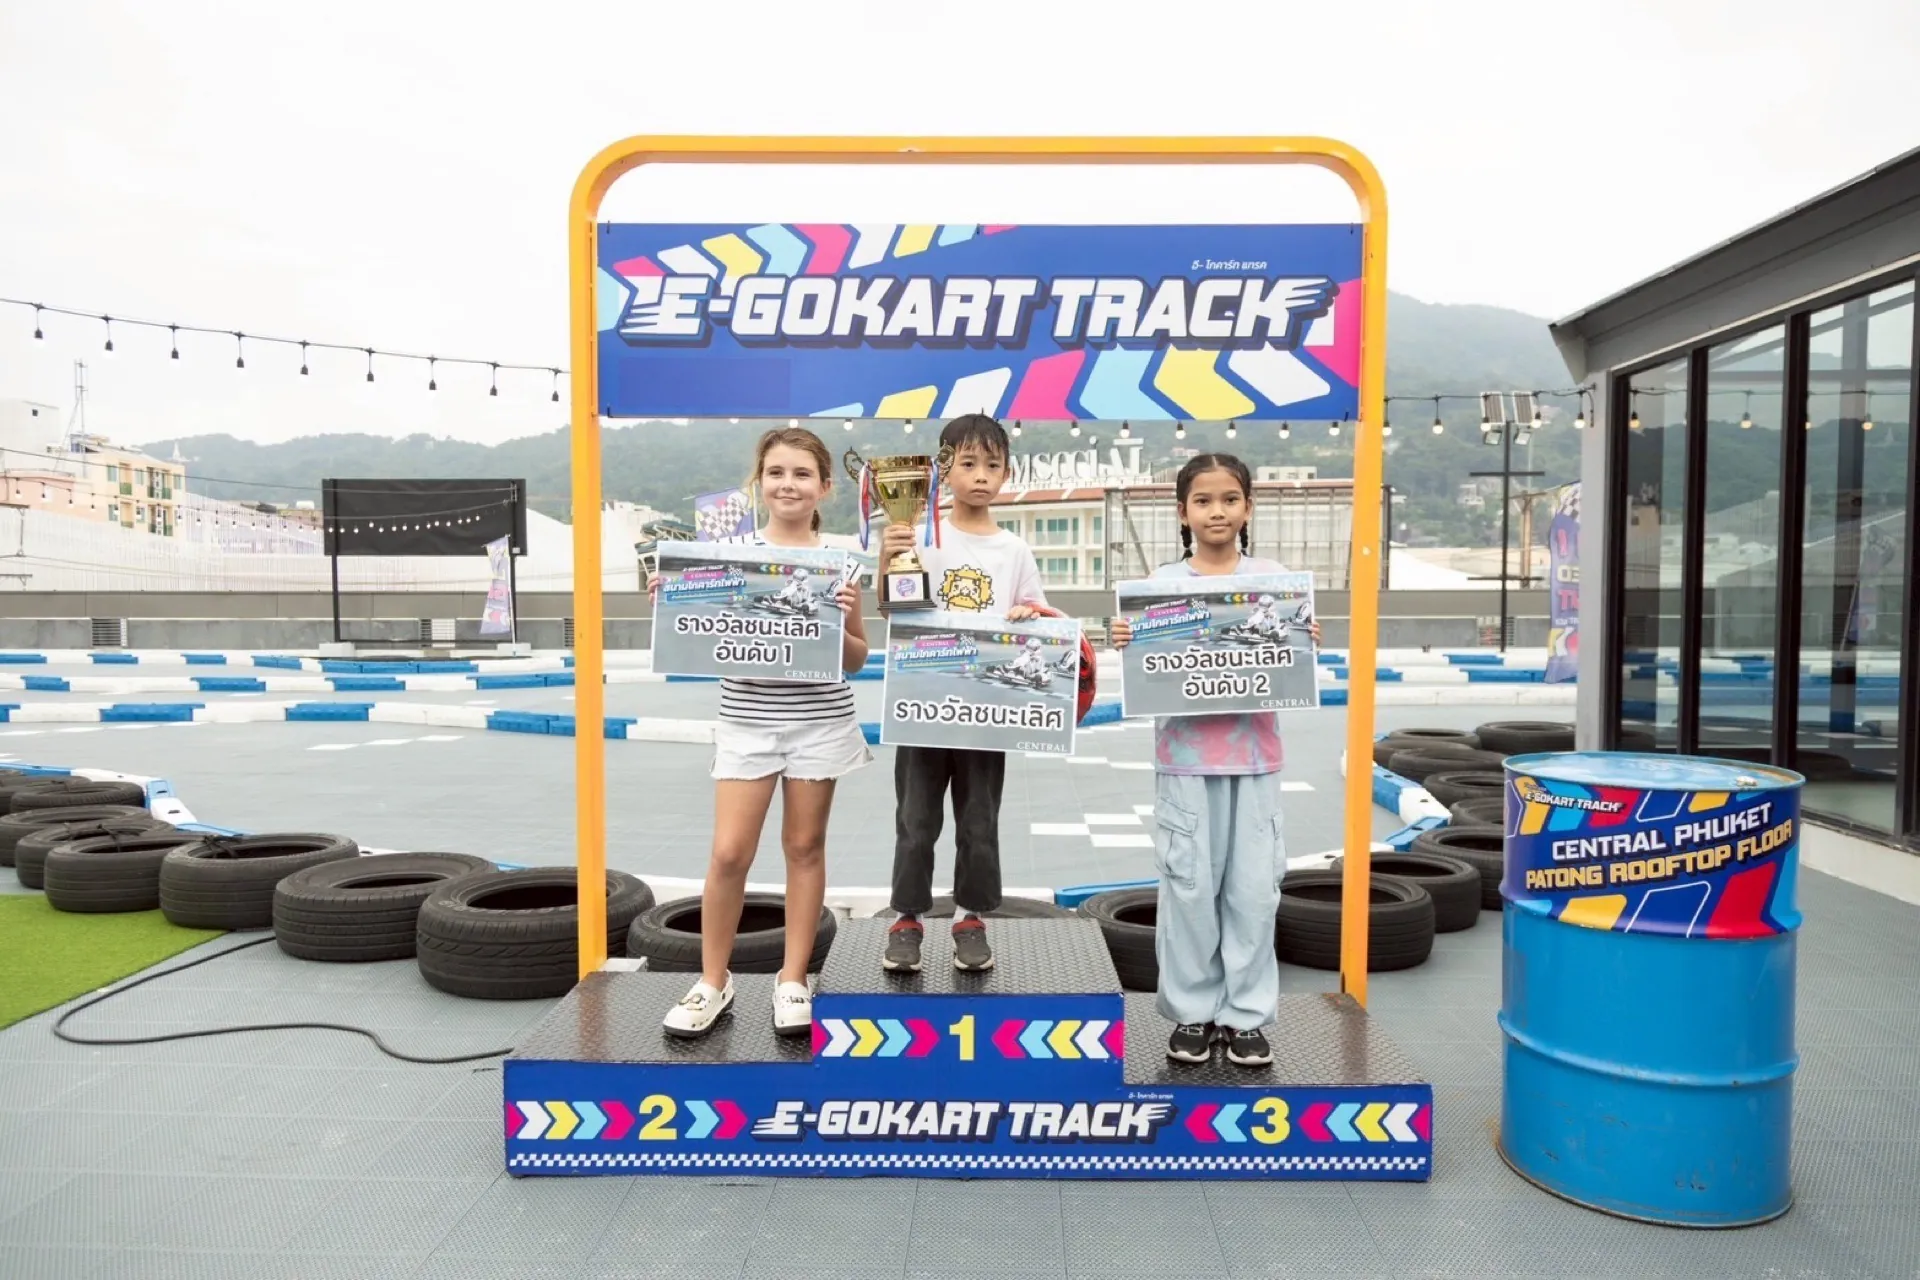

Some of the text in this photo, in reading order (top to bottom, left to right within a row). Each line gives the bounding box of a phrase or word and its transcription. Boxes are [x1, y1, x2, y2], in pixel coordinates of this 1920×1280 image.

[619, 276, 1328, 338] E-GOKART TRACK
[677, 612, 820, 638] รางวัลชนะเลิศ
[715, 640, 792, 664] อันดับ 1
[1144, 645, 1292, 671] รางวัลชนะเลิศ
[784, 670, 834, 680] CENTRAL
[1184, 674, 1270, 696] อันดับ 2
[895, 697, 1062, 728] รางวัลชนะเลิศ
[1260, 697, 1312, 709] CENTRAL
[1016, 741, 1066, 751] CENTRAL
[1578, 799, 1622, 813] TRACK
[1552, 801, 1772, 861] CENTRAL PHUKET
[1526, 818, 1793, 890] PATONG ROOFTOP FLOOR
[949, 1014, 975, 1061] 1
[638, 1094, 678, 1141] 2
[750, 1101, 1173, 1138] E-GOKART TRACK
[1251, 1096, 1291, 1145] 3
